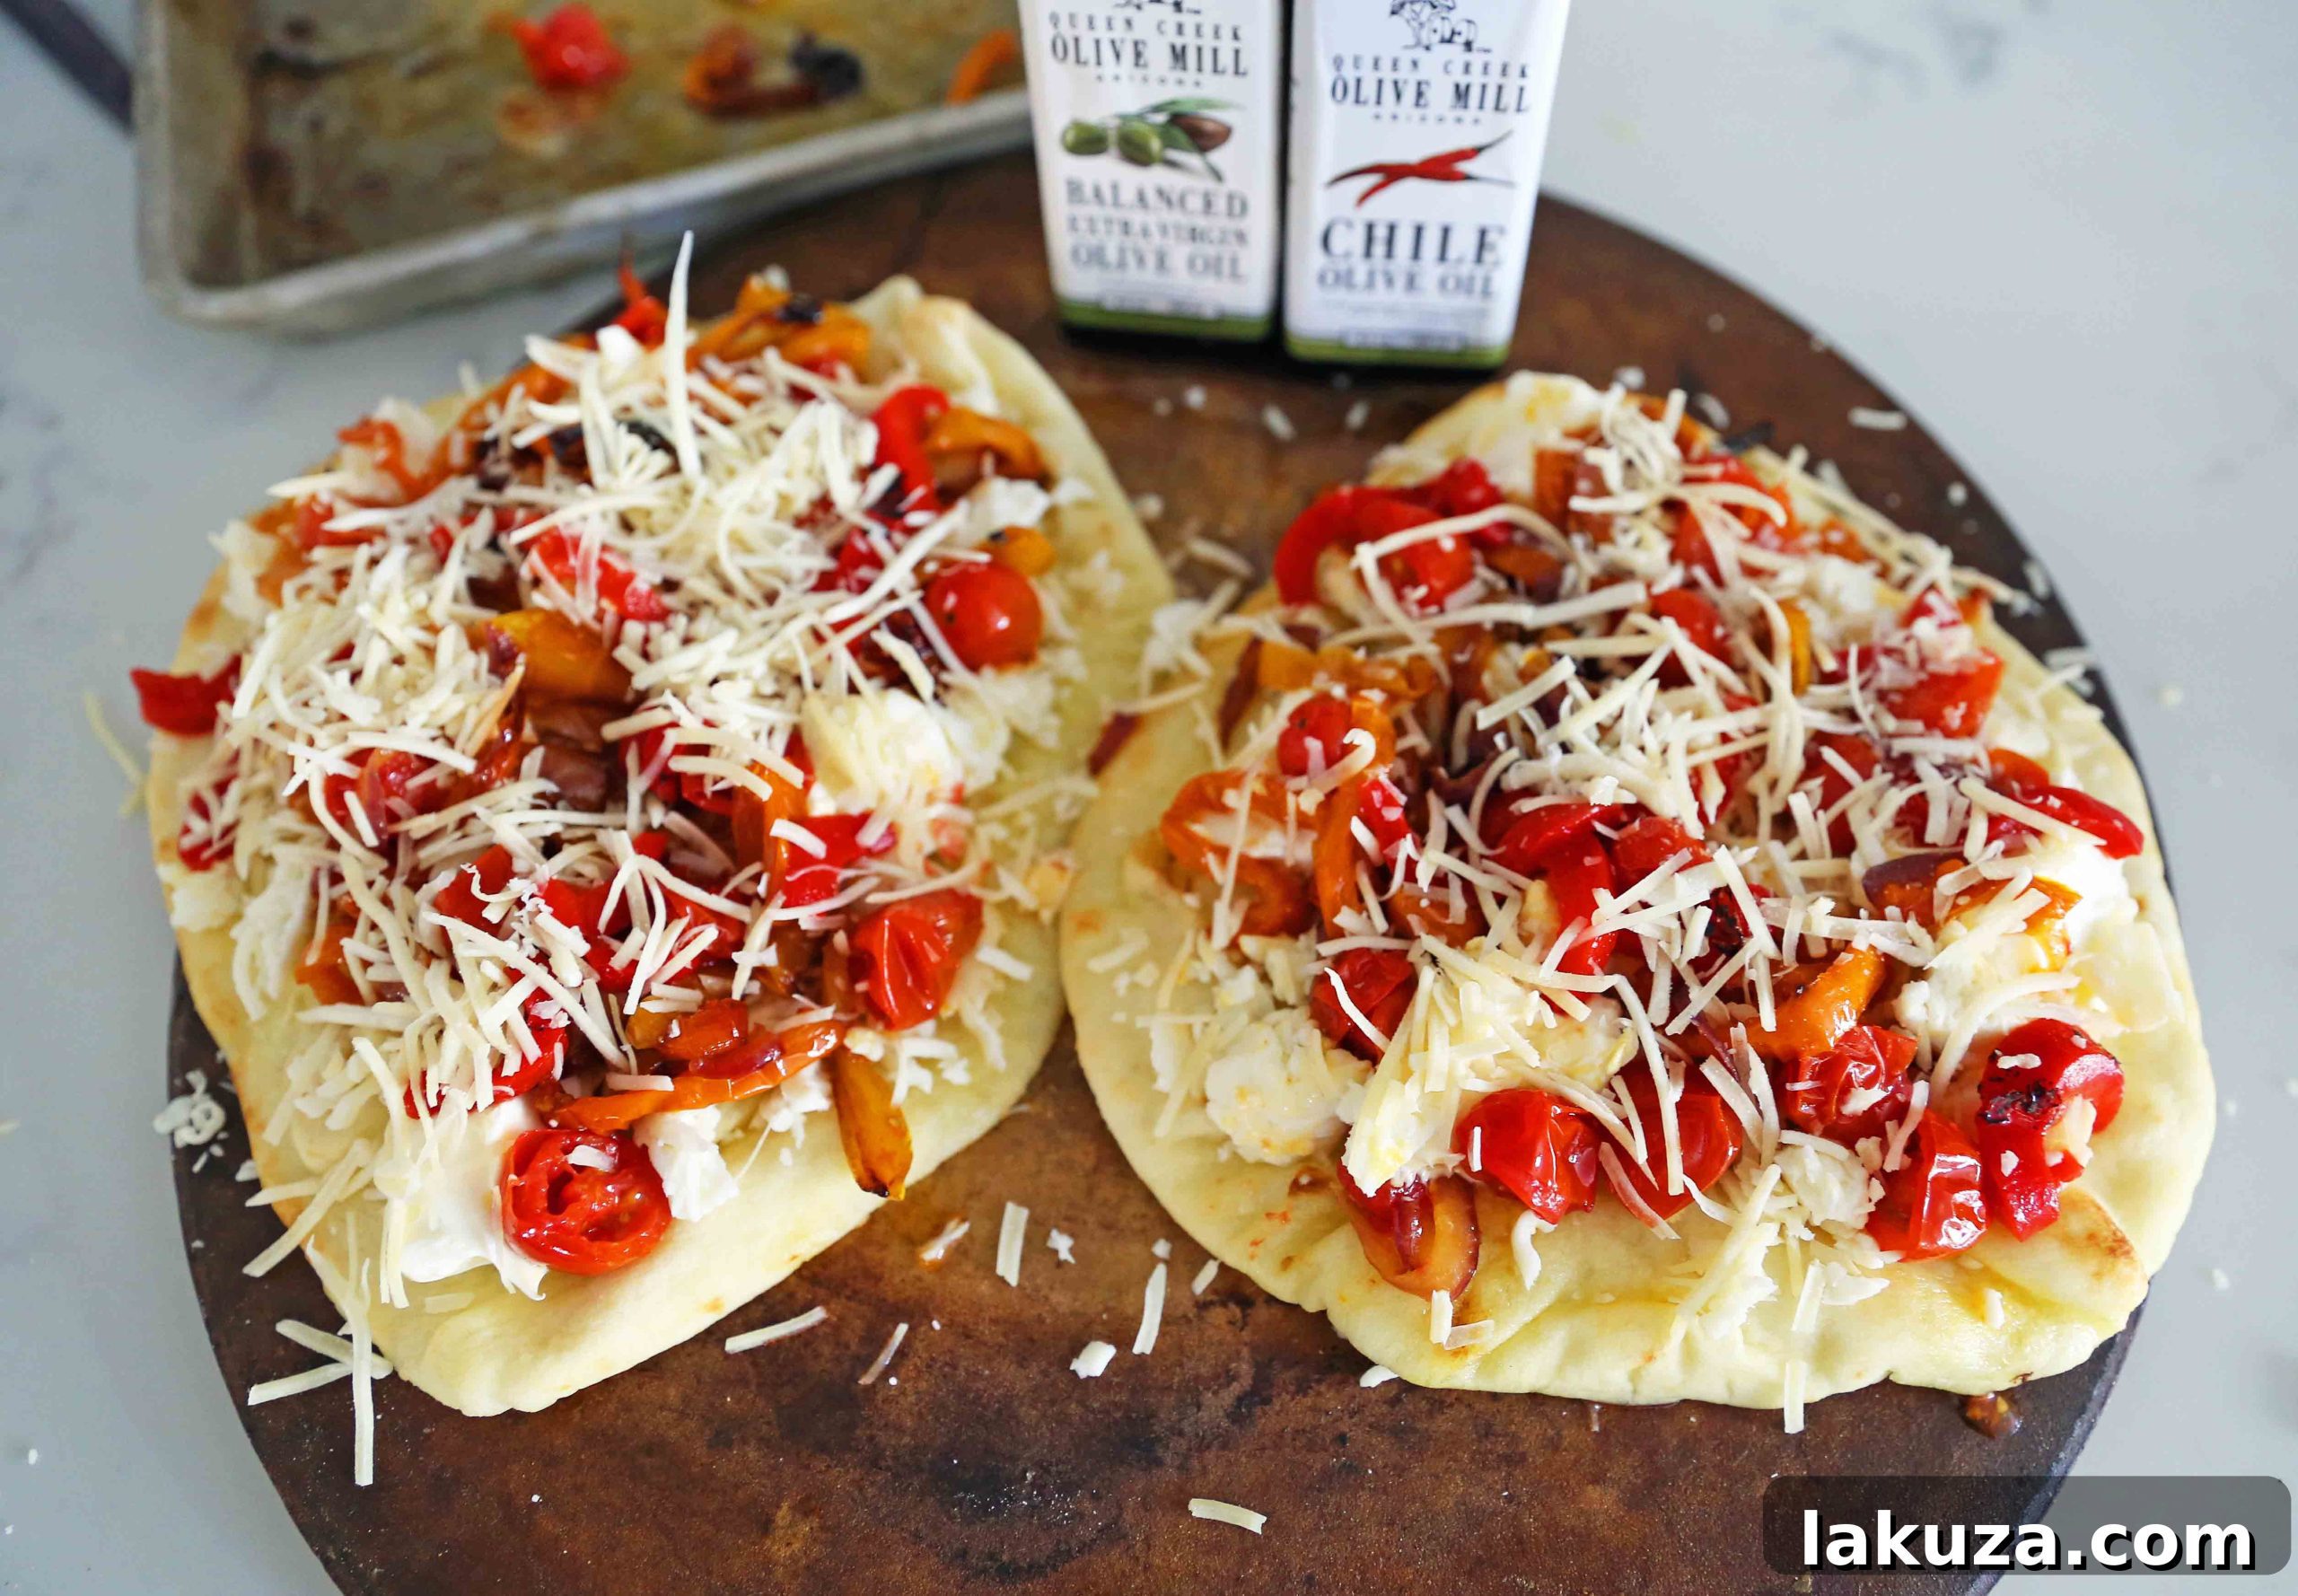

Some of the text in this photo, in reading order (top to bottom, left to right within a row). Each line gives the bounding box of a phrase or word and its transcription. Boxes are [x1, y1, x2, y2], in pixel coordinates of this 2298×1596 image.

[1051, 32, 1249, 77] OLIVE MILL
[1443, 59, 1530, 79] CREEK
[1330, 73, 1531, 113] OLIVE MILL
[1066, 178, 1250, 220] BALANCED
[1071, 242, 1246, 279] OLIVE OIL
[1320, 216, 1506, 265] CHILE
[1317, 265, 1496, 299] OLIVE OIL
